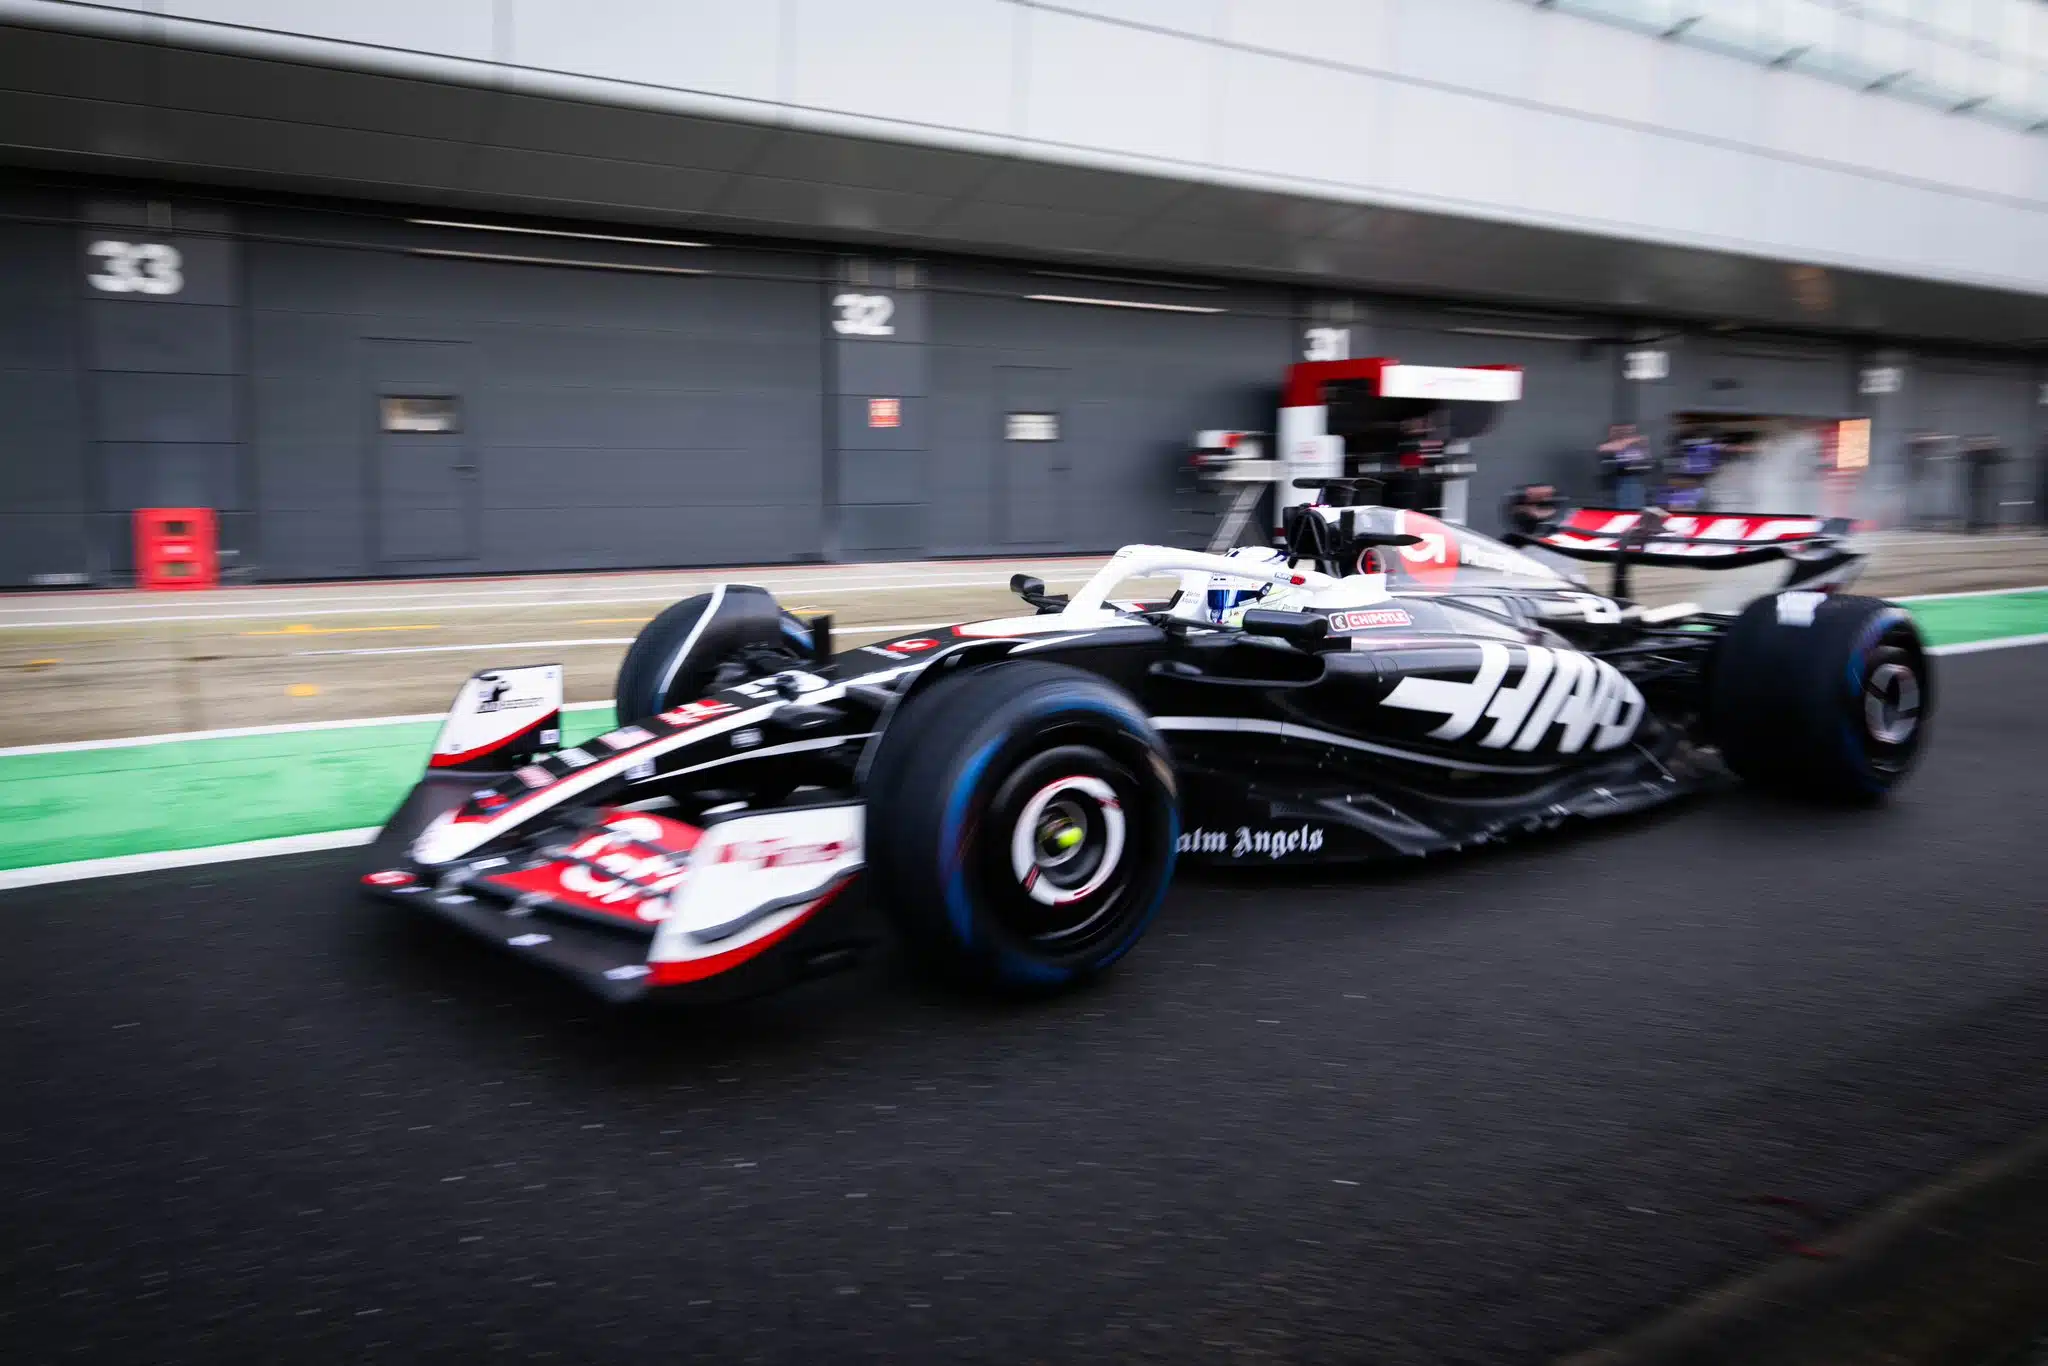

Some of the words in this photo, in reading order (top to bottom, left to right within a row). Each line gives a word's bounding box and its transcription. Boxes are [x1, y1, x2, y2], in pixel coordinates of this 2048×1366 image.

[85, 240, 184, 294] 33
[832, 294, 895, 335] 32
[1304, 328, 1350, 361] 31
[1349, 610, 1407, 626] CHIPOTLE
[1176, 826, 1229, 852] alm
[1231, 823, 1324, 860] Angels
